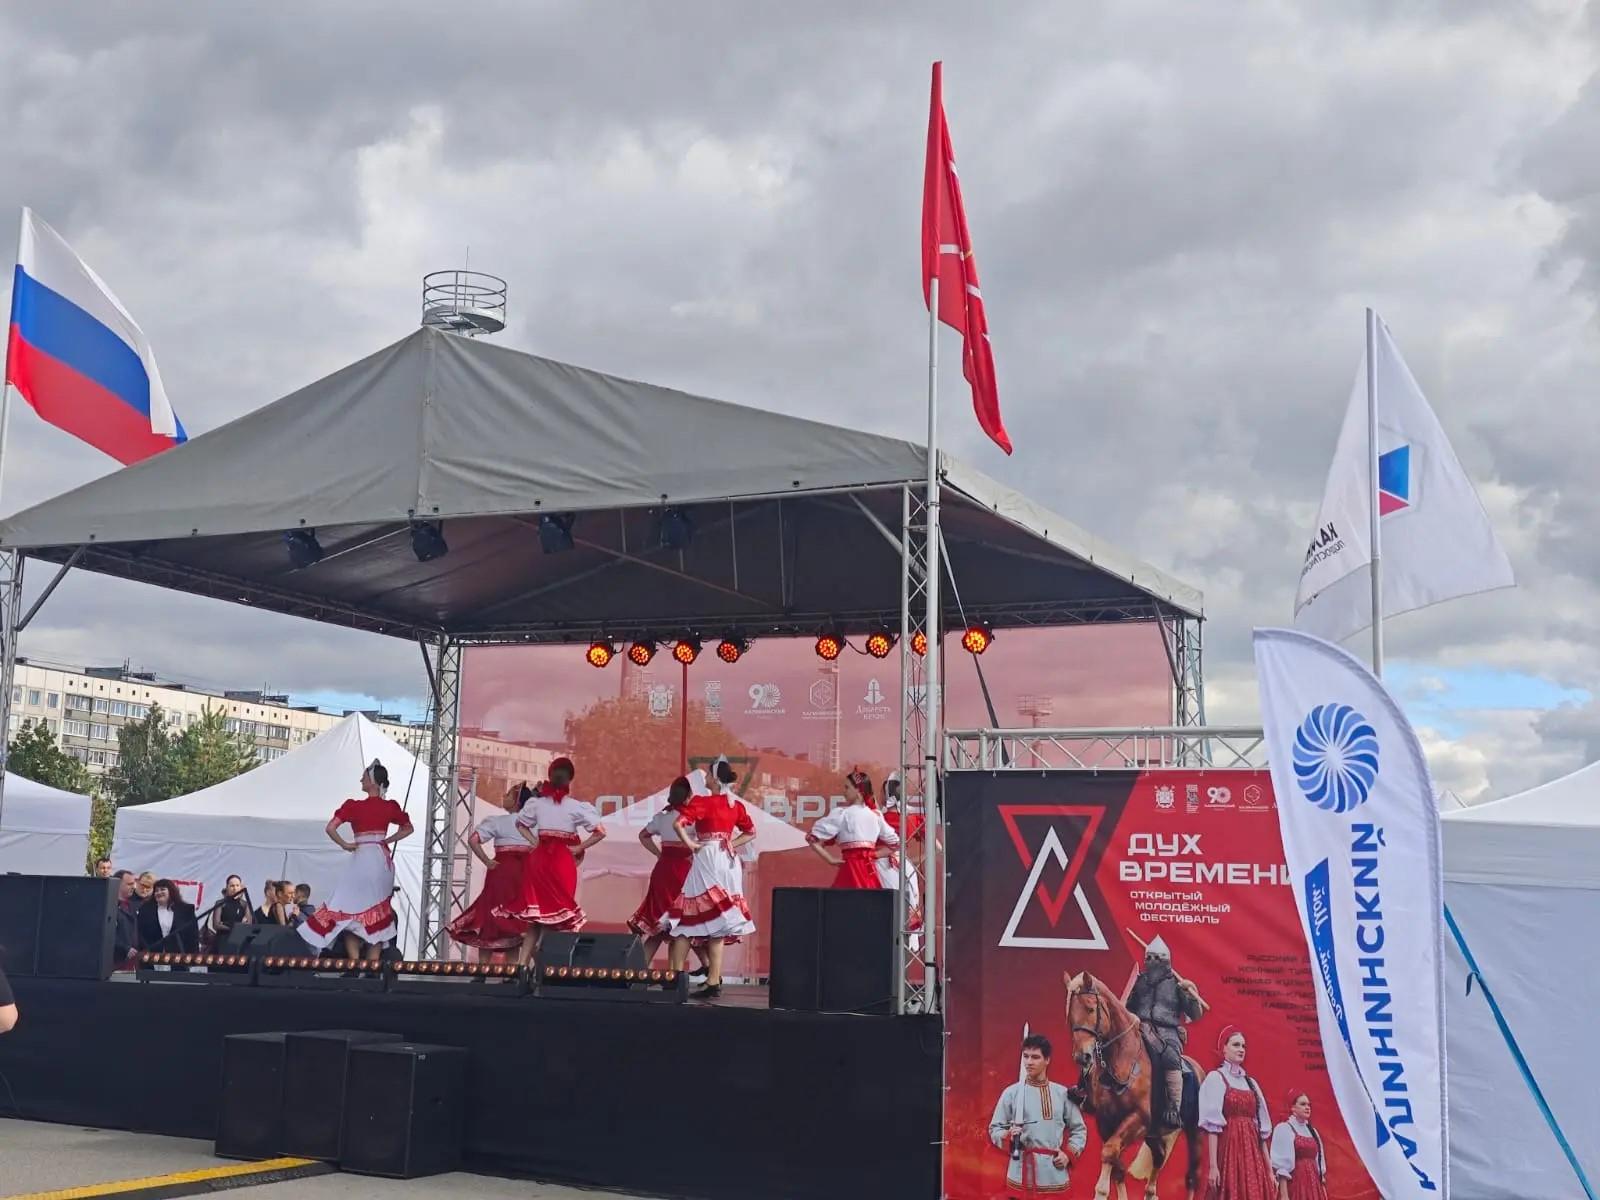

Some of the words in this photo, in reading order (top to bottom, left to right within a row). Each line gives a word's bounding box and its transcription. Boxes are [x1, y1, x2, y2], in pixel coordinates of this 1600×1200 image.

[1127, 833, 1203, 857] ДУХ
[1130, 890, 1203, 900] ОТКРЫТЫЙ
[1140, 913, 1220, 924] ФЕСТИВАЛЬ
